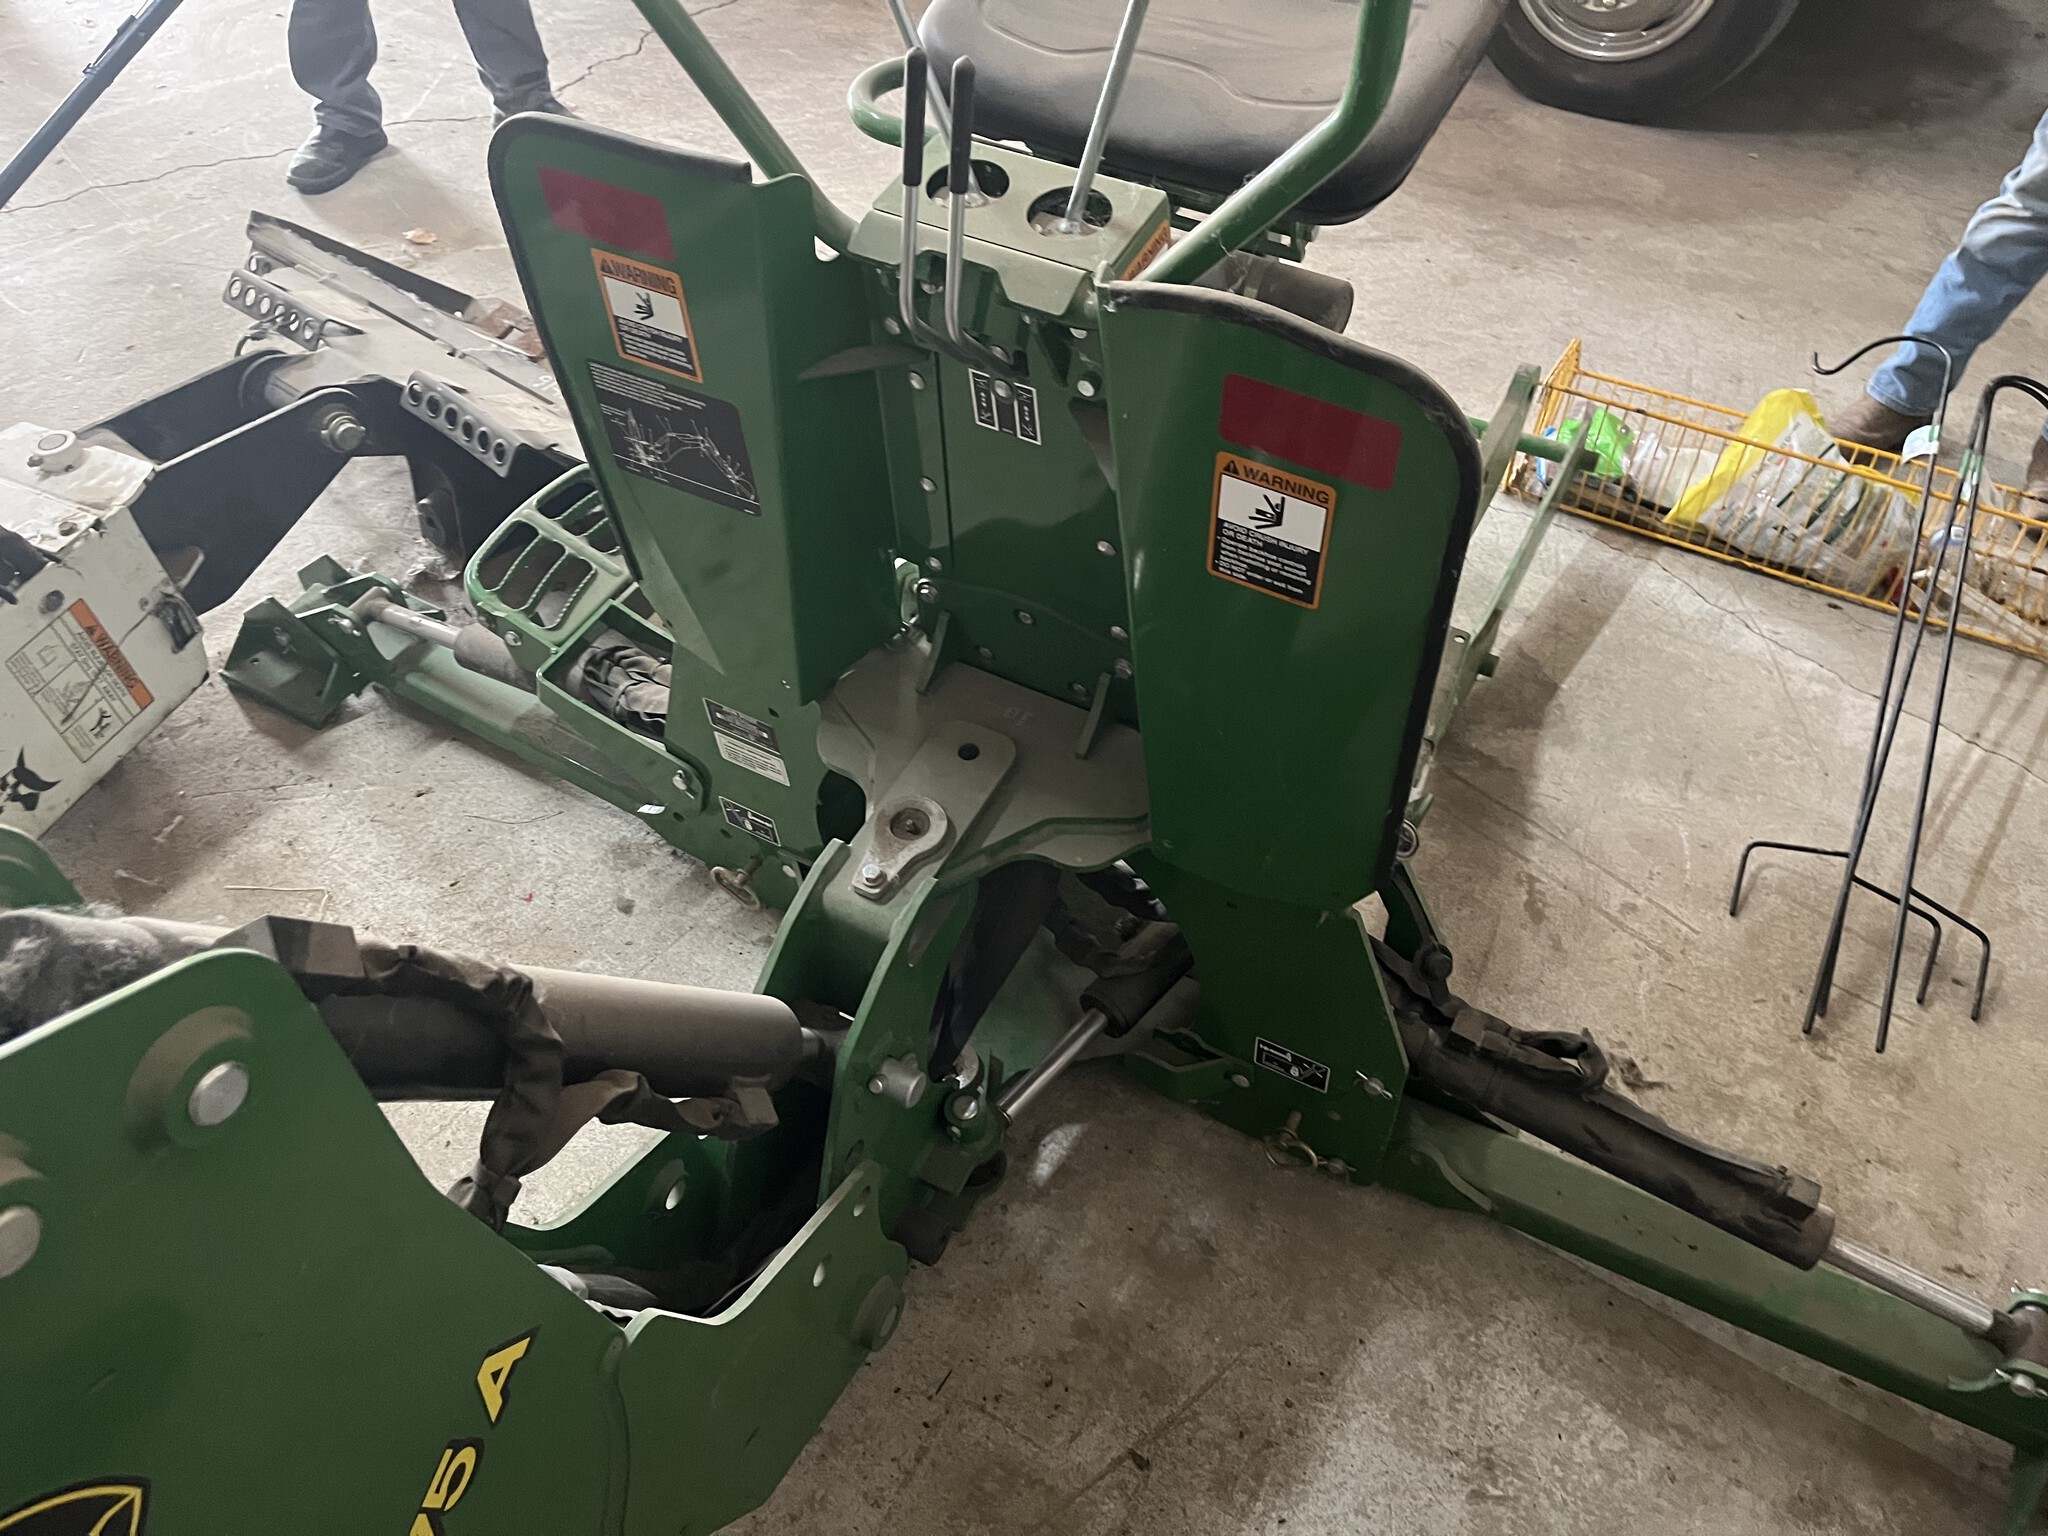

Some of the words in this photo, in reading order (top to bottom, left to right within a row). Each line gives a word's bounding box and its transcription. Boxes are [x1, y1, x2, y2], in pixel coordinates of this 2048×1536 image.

[610, 260, 677, 295] WARNING
[1243, 465, 1330, 504] WARNING
[1221, 528, 1235, 538] OR
[1234, 532, 1263, 548] DEATH
